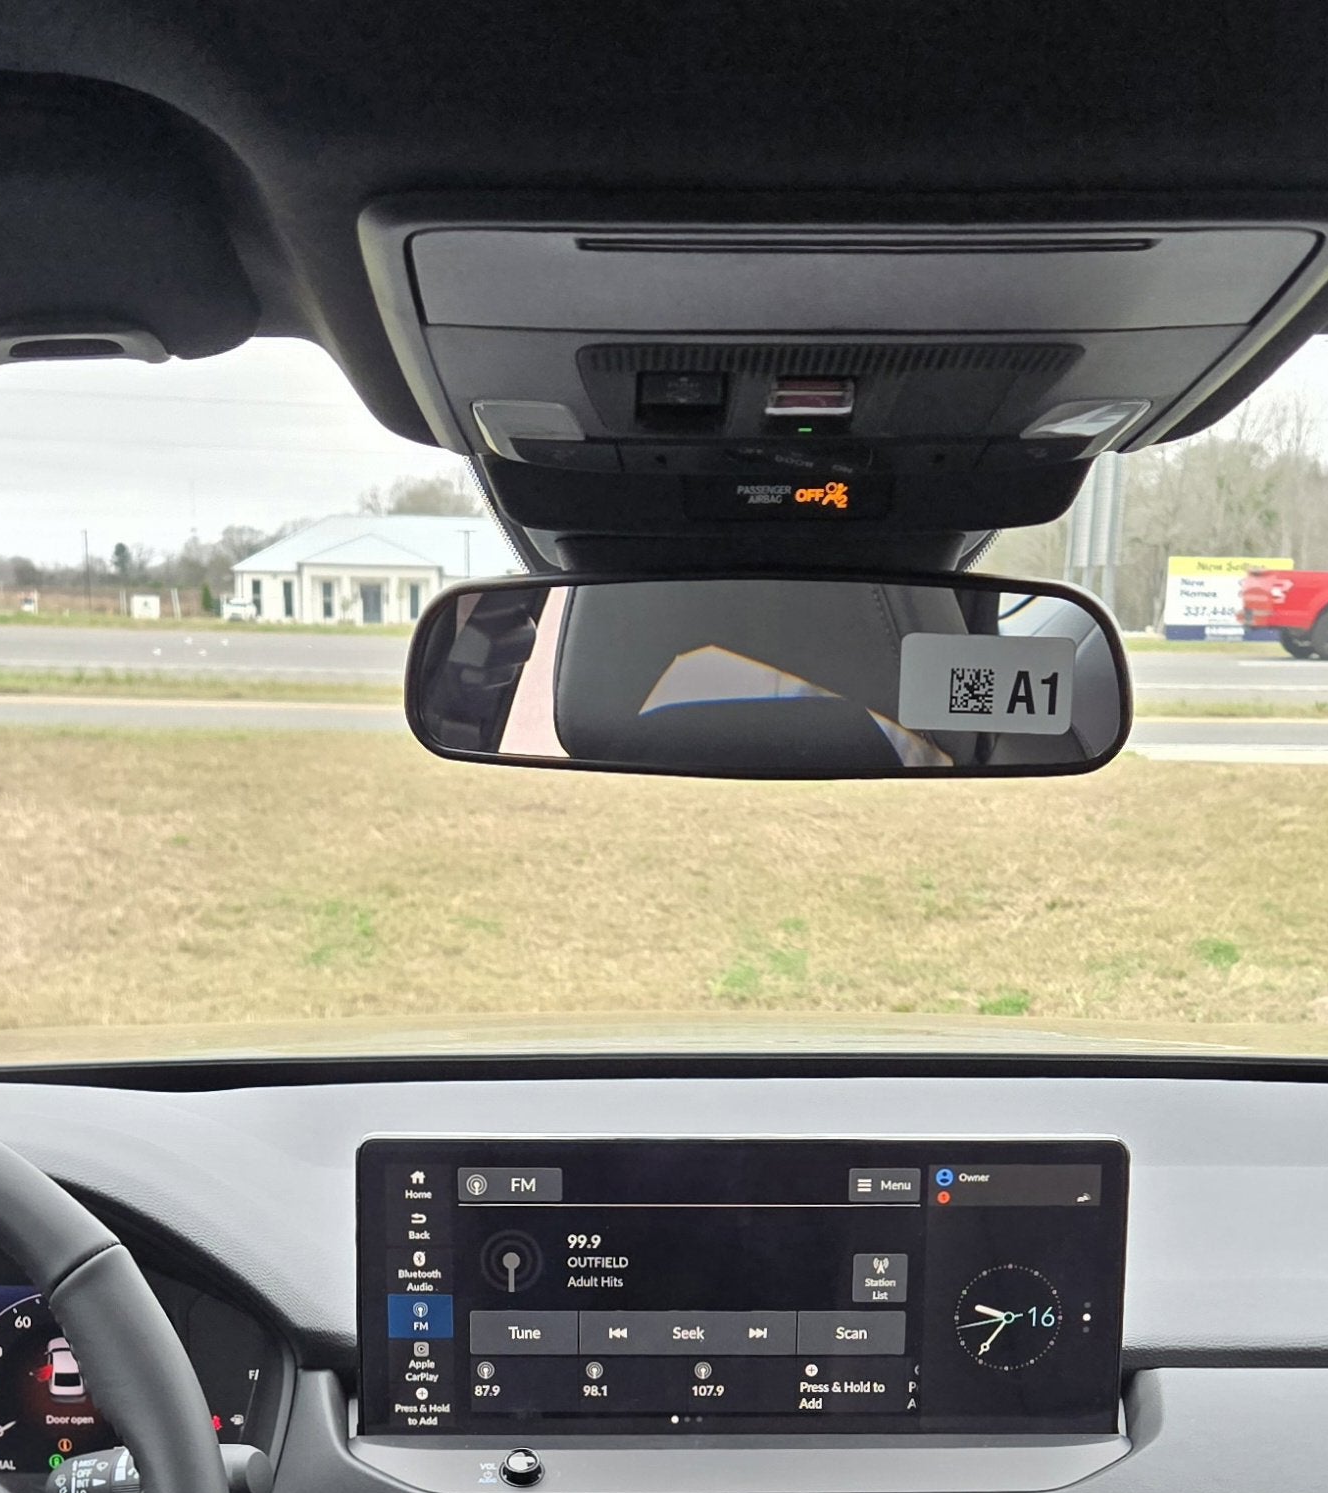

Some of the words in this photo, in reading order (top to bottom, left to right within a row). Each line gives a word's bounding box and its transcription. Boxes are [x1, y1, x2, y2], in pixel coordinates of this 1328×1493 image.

[736, 484, 792, 496] PASSENGER
[794, 487, 824, 503] OFF
[747, 494, 783, 504] AIRBAG
[1006, 670, 1059, 715] A1
[958, 1172, 990, 1183] Owner
[510, 1178, 537, 1193] FM
[880, 1179, 912, 1191] Menu
[405, 1189, 433, 1200] Home
[408, 1230, 430, 1240] Back
[567, 1234, 602, 1249] 99.9
[567, 1256, 629, 1269] OUTFIELD
[398, 1269, 442, 1279] Bluetooth
[406, 1282, 434, 1292] Audio
[567, 1275, 598, 1288] Adult
[601, 1276, 624, 1288] Hits
[864, 1277, 896, 1287] Station
[872, 1290, 889, 1300] List
[14, 1316, 32, 1329] 60
[1027, 1306, 1056, 1328] 16
[413, 1321, 429, 1332] FM
[508, 1326, 542, 1340] Tune
[672, 1326, 705, 1340] Seek
[835, 1326, 868, 1340] Scan
[408, 1359, 436, 1371] Apple
[405, 1372, 439, 1383] CarPlay
[474, 1385, 501, 1397] 87.9
[583, 1385, 608, 1397] 98.1
[692, 1385, 725, 1397] 107.9
[800, 1381, 829, 1394] Press
[831, 1382, 841, 1393] &
[844, 1381, 872, 1394] Hold
[873, 1382, 885, 1393] to
[395, 1403, 418, 1413] Press
[419, 1403, 428, 1413] &
[429, 1403, 451, 1413] Hold
[799, 1398, 823, 1410] Add
[46, 1414, 69, 1425] Door
[70, 1416, 94, 1427] open
[408, 1417, 417, 1426] to
[419, 1416, 438, 1426] Add
[76, 1468, 93, 1479] OFF
